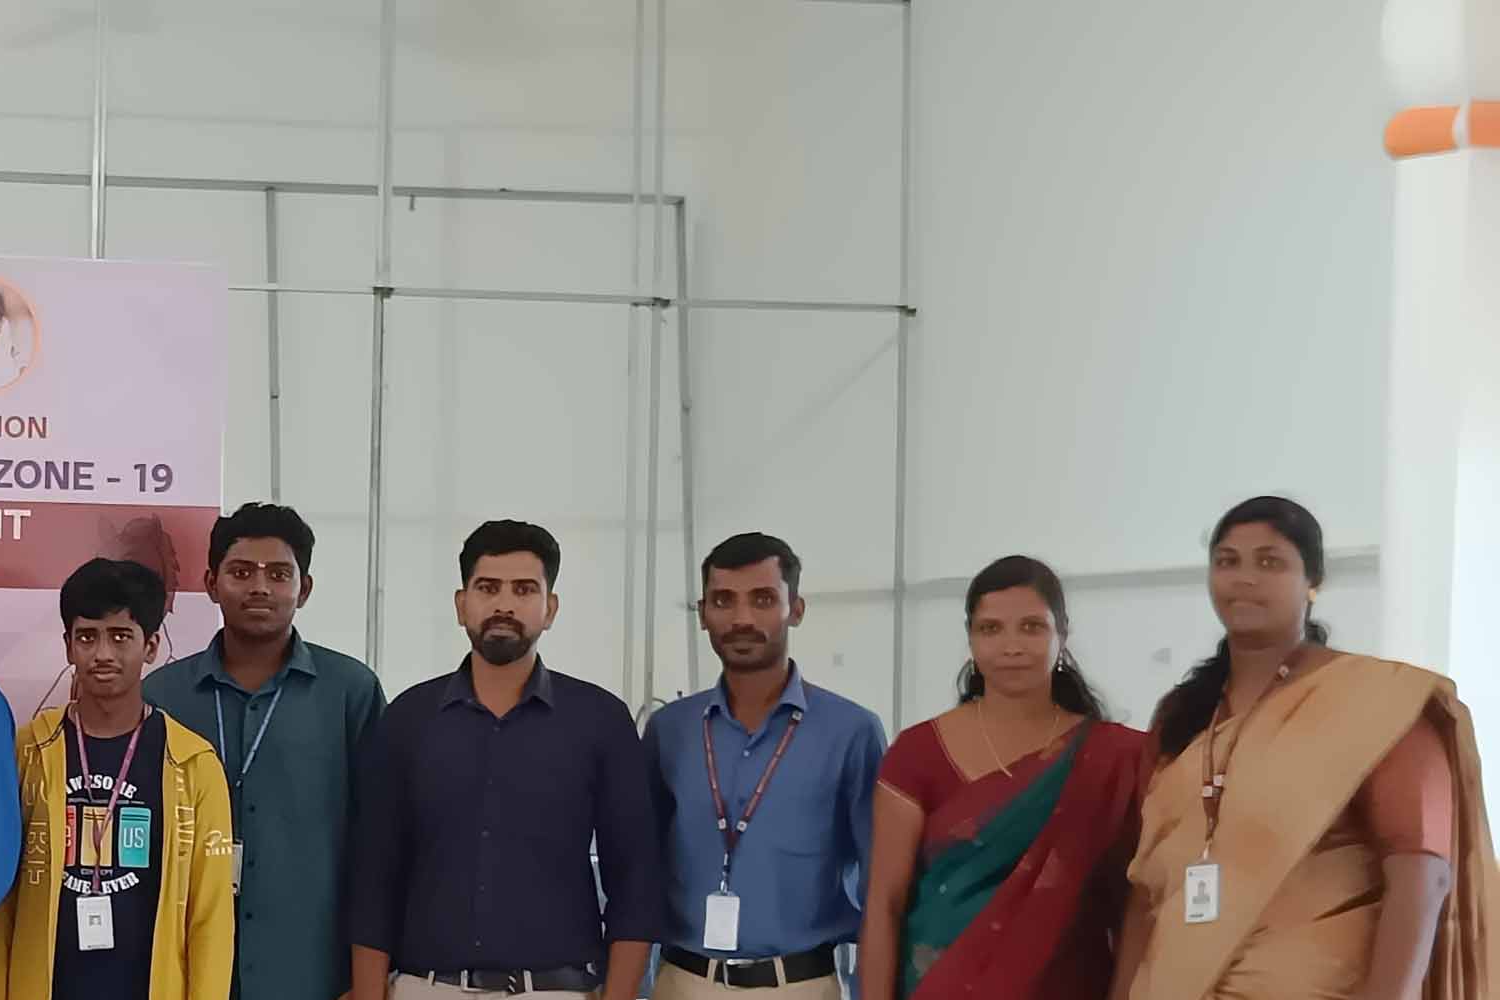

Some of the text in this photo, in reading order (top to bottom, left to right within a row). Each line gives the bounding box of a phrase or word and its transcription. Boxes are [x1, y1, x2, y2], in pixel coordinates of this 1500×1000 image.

[133, 463, 174, 493] 19
[123, 827, 145, 849] US
[101, 871, 140, 894] EVER
